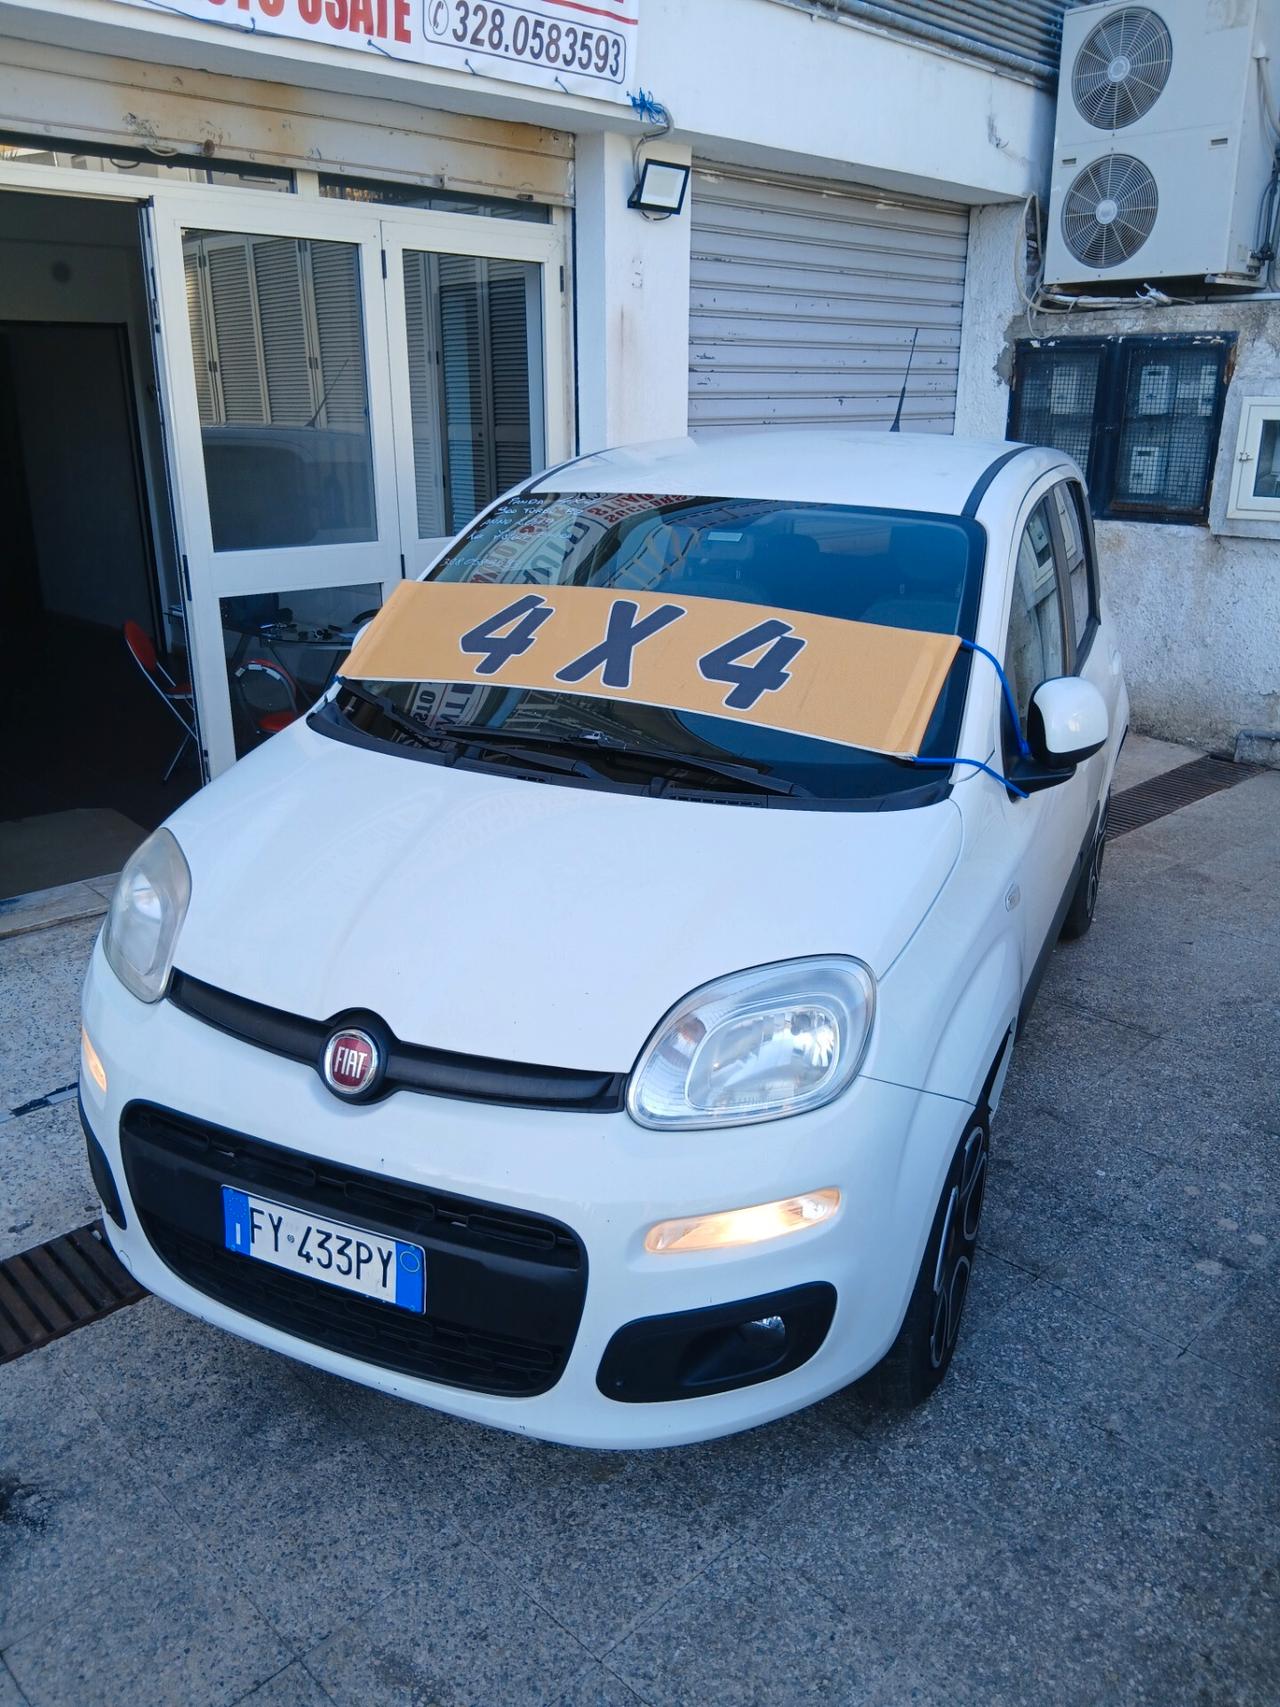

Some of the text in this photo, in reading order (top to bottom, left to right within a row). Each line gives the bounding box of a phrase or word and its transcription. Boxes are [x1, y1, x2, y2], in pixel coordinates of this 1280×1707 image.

[452, 1, 621, 77] 328.0583593
[459, 593, 807, 711] 4 X 4
[334, 1046, 368, 1079] FIAT
